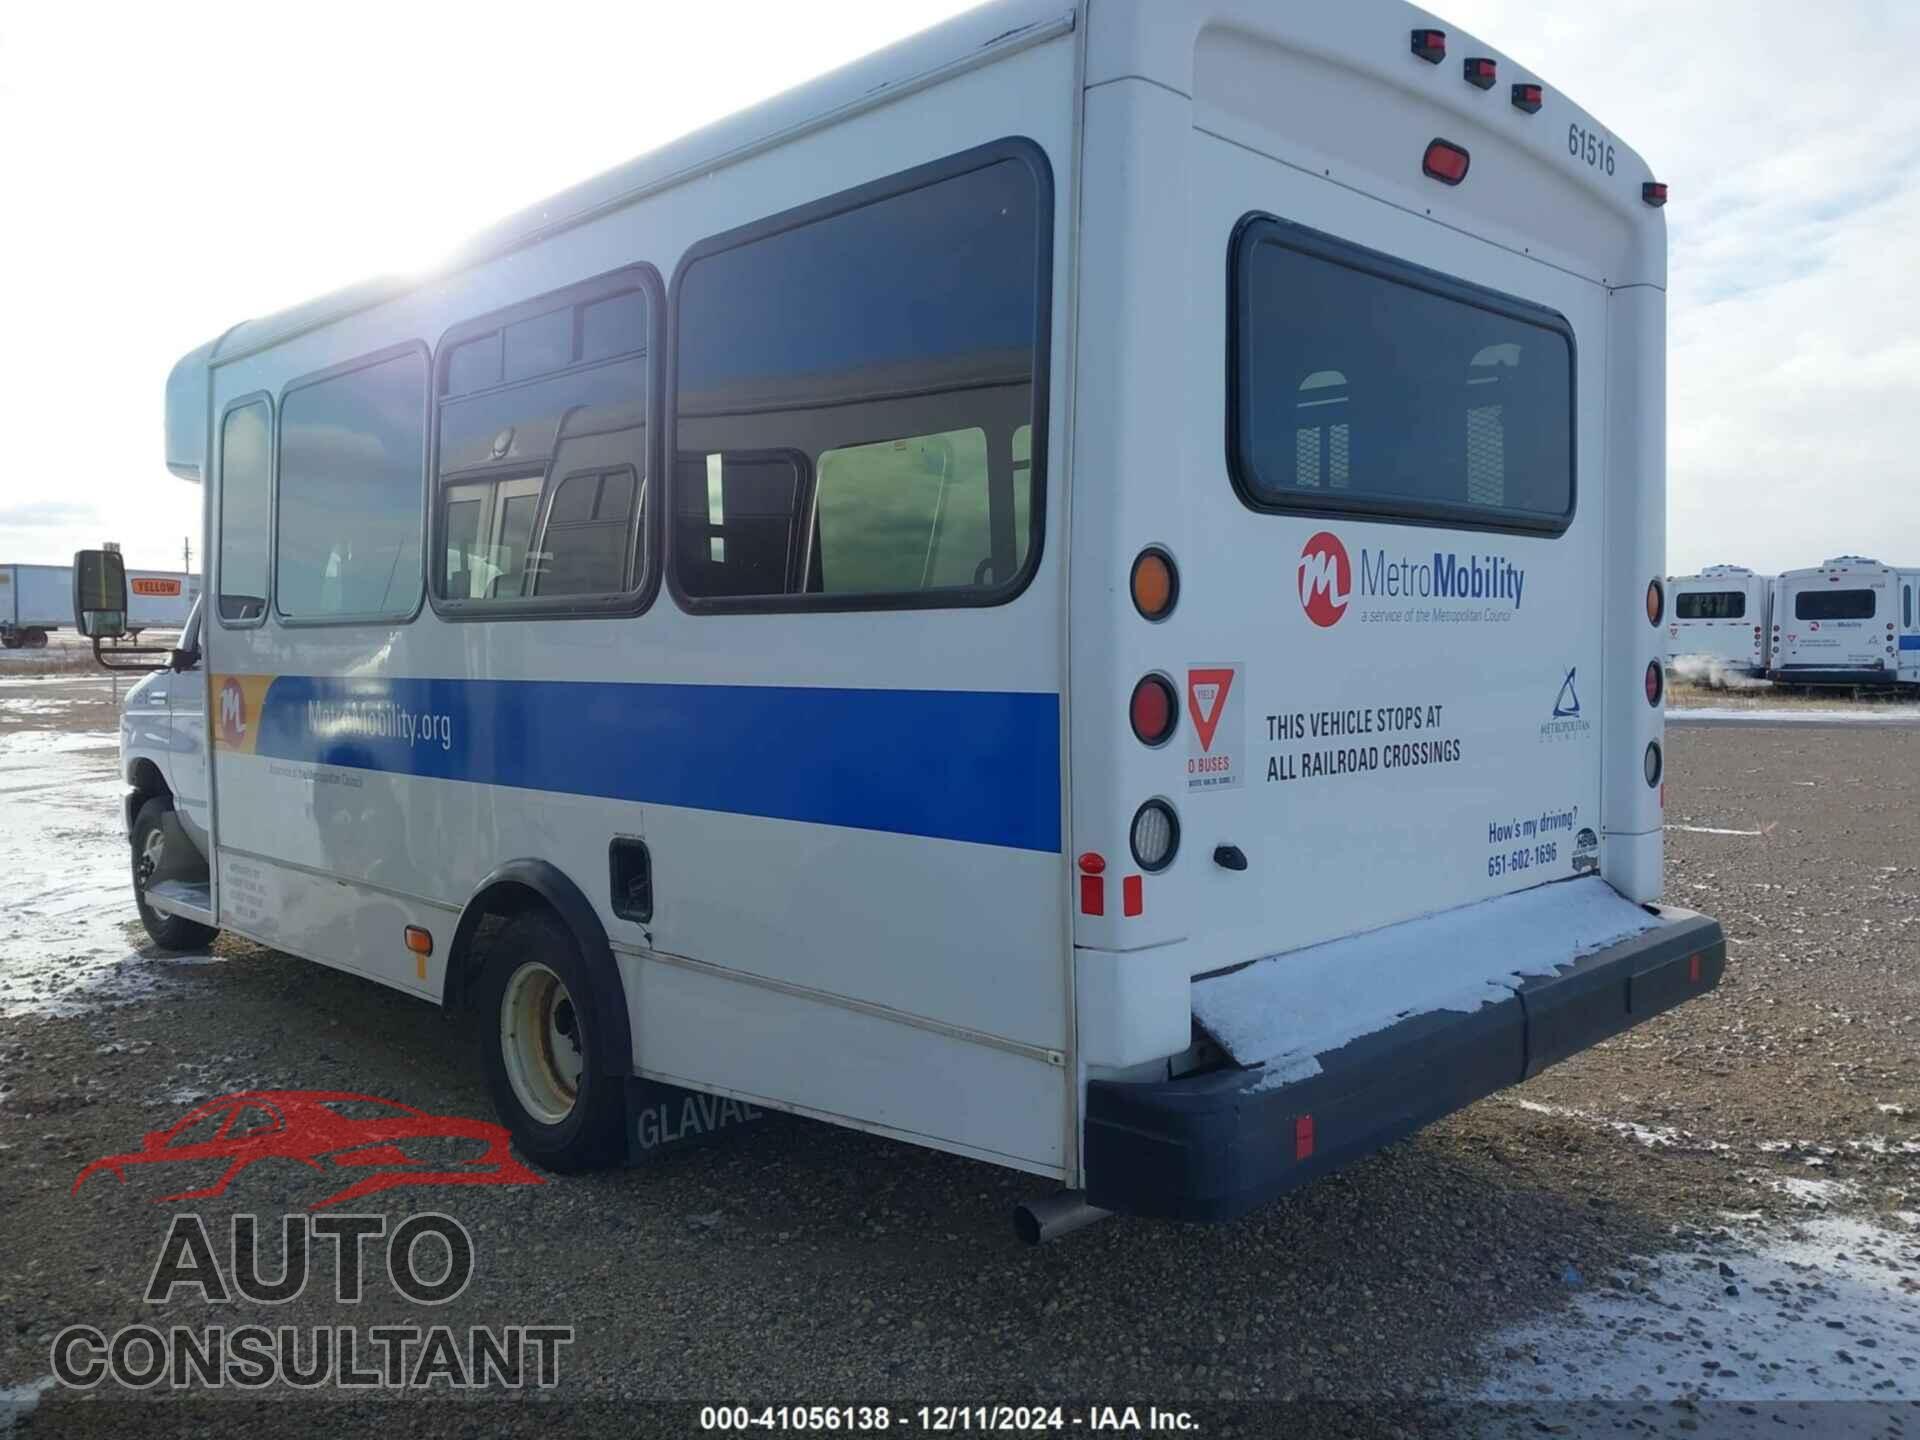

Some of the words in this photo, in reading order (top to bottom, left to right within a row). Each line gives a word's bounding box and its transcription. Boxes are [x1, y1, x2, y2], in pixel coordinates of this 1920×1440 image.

[1568, 122, 1615, 177] 61516
[137, 581, 176, 593] YELLOW
[1360, 548, 1525, 610] MetroMobility
[1266, 713, 1305, 741] THIS
[1310, 709, 1373, 737] VEHICLE
[1377, 706, 1422, 732] STOPS
[1426, 705, 1443, 728] AT
[1198, 756, 1230, 773] BUSES
[1266, 754, 1297, 782] ALL
[1302, 746, 1378, 778] RAILROAD
[1383, 738, 1461, 769] CROSSINGS
[1488, 817, 1521, 844] How's
[1523, 819, 1538, 839] my
[1540, 805, 1578, 831] driving?
[1488, 842, 1557, 877] 651-602-1696
